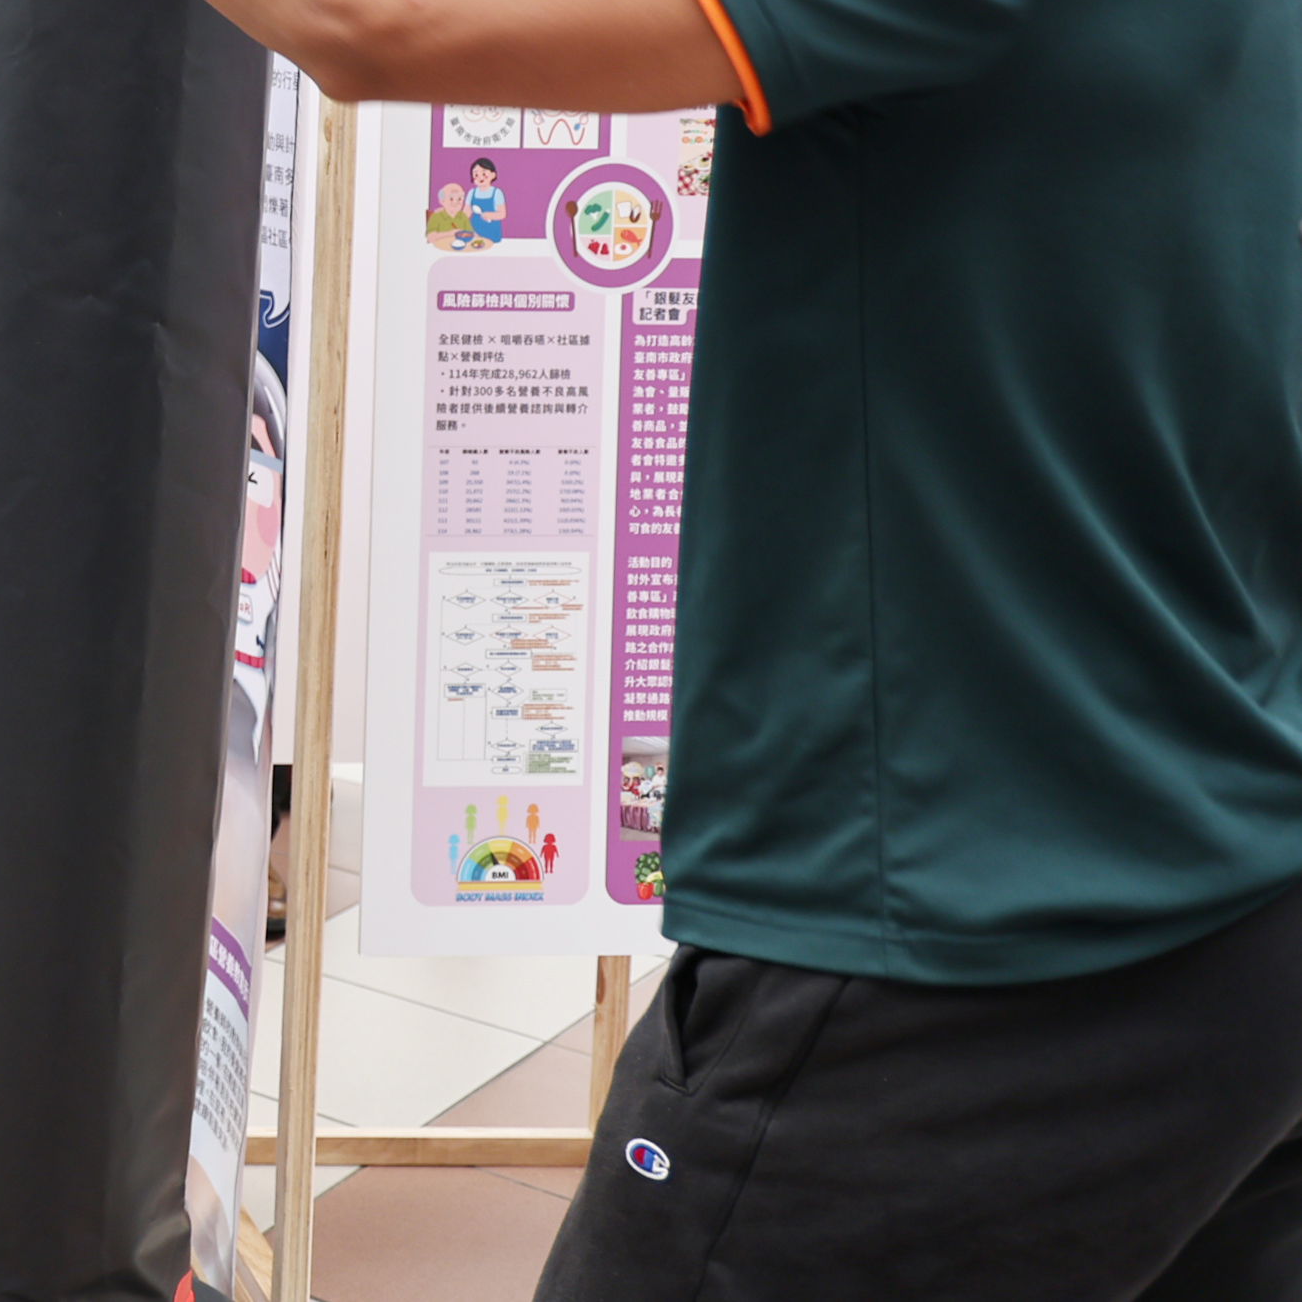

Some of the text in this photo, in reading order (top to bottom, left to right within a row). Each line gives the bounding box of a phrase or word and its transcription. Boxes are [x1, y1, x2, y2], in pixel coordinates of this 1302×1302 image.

[639, 307, 680, 321] 記者會
[625, 624, 676, 637] 展現政府
[491, 871, 509, 879] BMI
